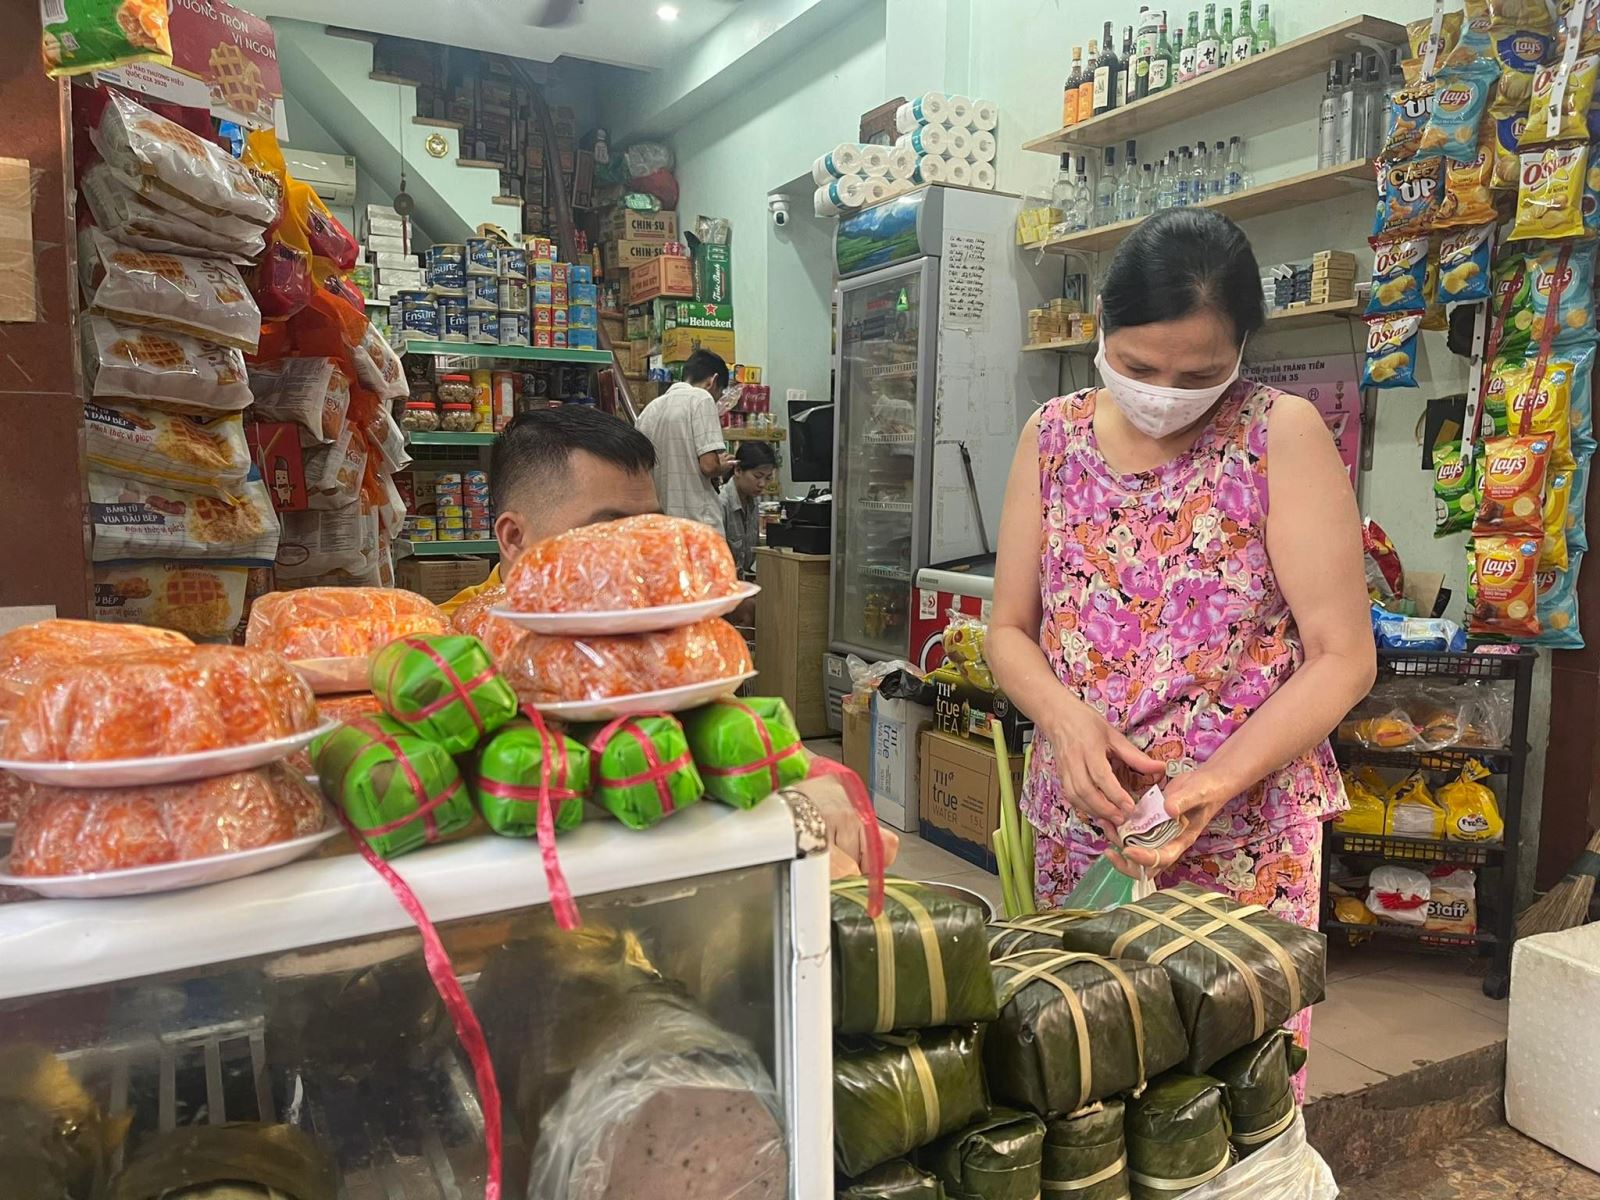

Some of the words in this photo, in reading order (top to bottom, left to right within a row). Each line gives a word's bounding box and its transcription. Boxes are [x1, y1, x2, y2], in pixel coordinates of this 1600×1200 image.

[220, 12, 249, 33] TRÒN
[232, 32, 243, 48] VỊ
[246, 40, 277, 60] NGON
[1514, 39, 1542, 55] Lay's
[1440, 89, 1471, 105] Lay's
[1400, 178, 1437, 202] UP
[632, 220, 664, 231] CHIN-SU
[405, 309, 436, 321] Ensure
[689, 317, 732, 328] Heineken
[1309, 360, 1325, 370] TIỀN
[1289, 373, 1299, 381] 35
[1437, 463, 1464, 480] Lay's
[1490, 456, 1525, 476] Lay's
[102, 515, 120, 523] VUA
[1482, 557, 1516, 577] Lay's
[936, 681, 951, 698] TH
[936, 697, 960, 717] true
[936, 712, 959, 736] TEA
[882, 724, 891, 759] true
[933, 786, 958, 811] true
[932, 803, 958, 825] WATER
[1427, 901, 1467, 917] Staff
